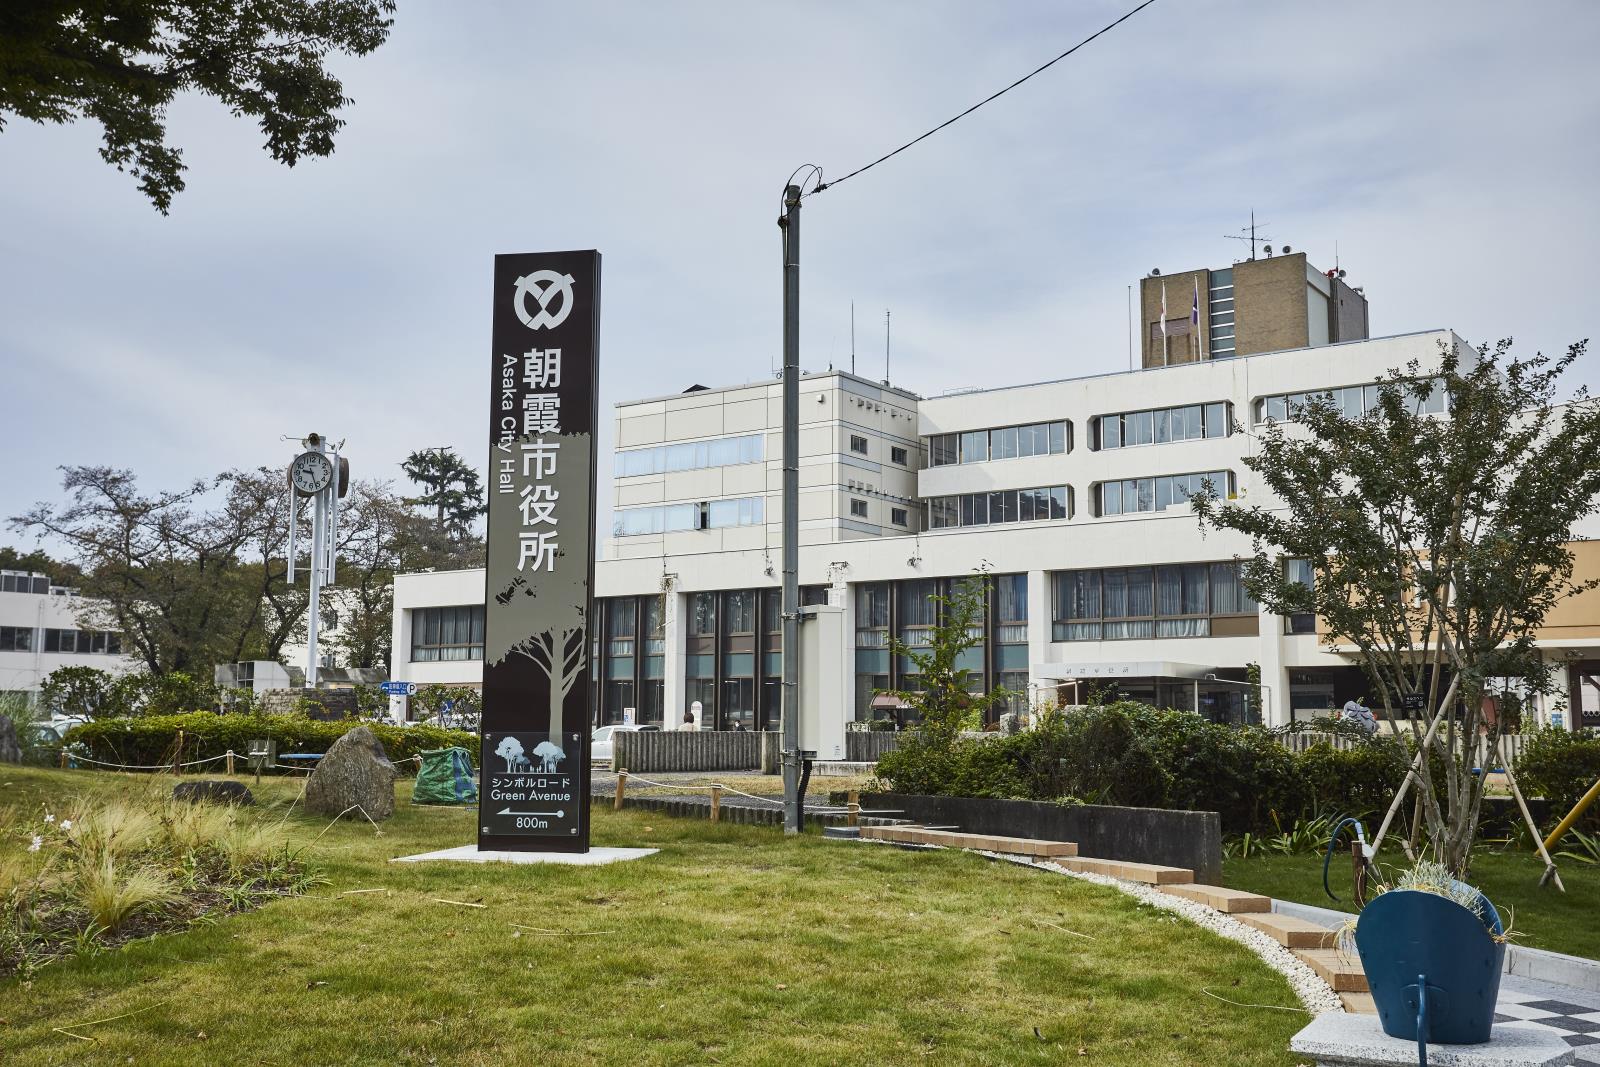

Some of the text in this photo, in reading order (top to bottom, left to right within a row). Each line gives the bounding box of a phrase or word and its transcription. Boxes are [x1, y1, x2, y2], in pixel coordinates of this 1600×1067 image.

[498, 353, 518, 494] Asaka City Hall
[517, 347, 561, 572] 朝霞市役所
[410, 684, 415, 693] P
[492, 777, 570, 788] シンボルロード
[491, 789, 571, 801] Green Avenue
[516, 817, 548, 829] 800m
